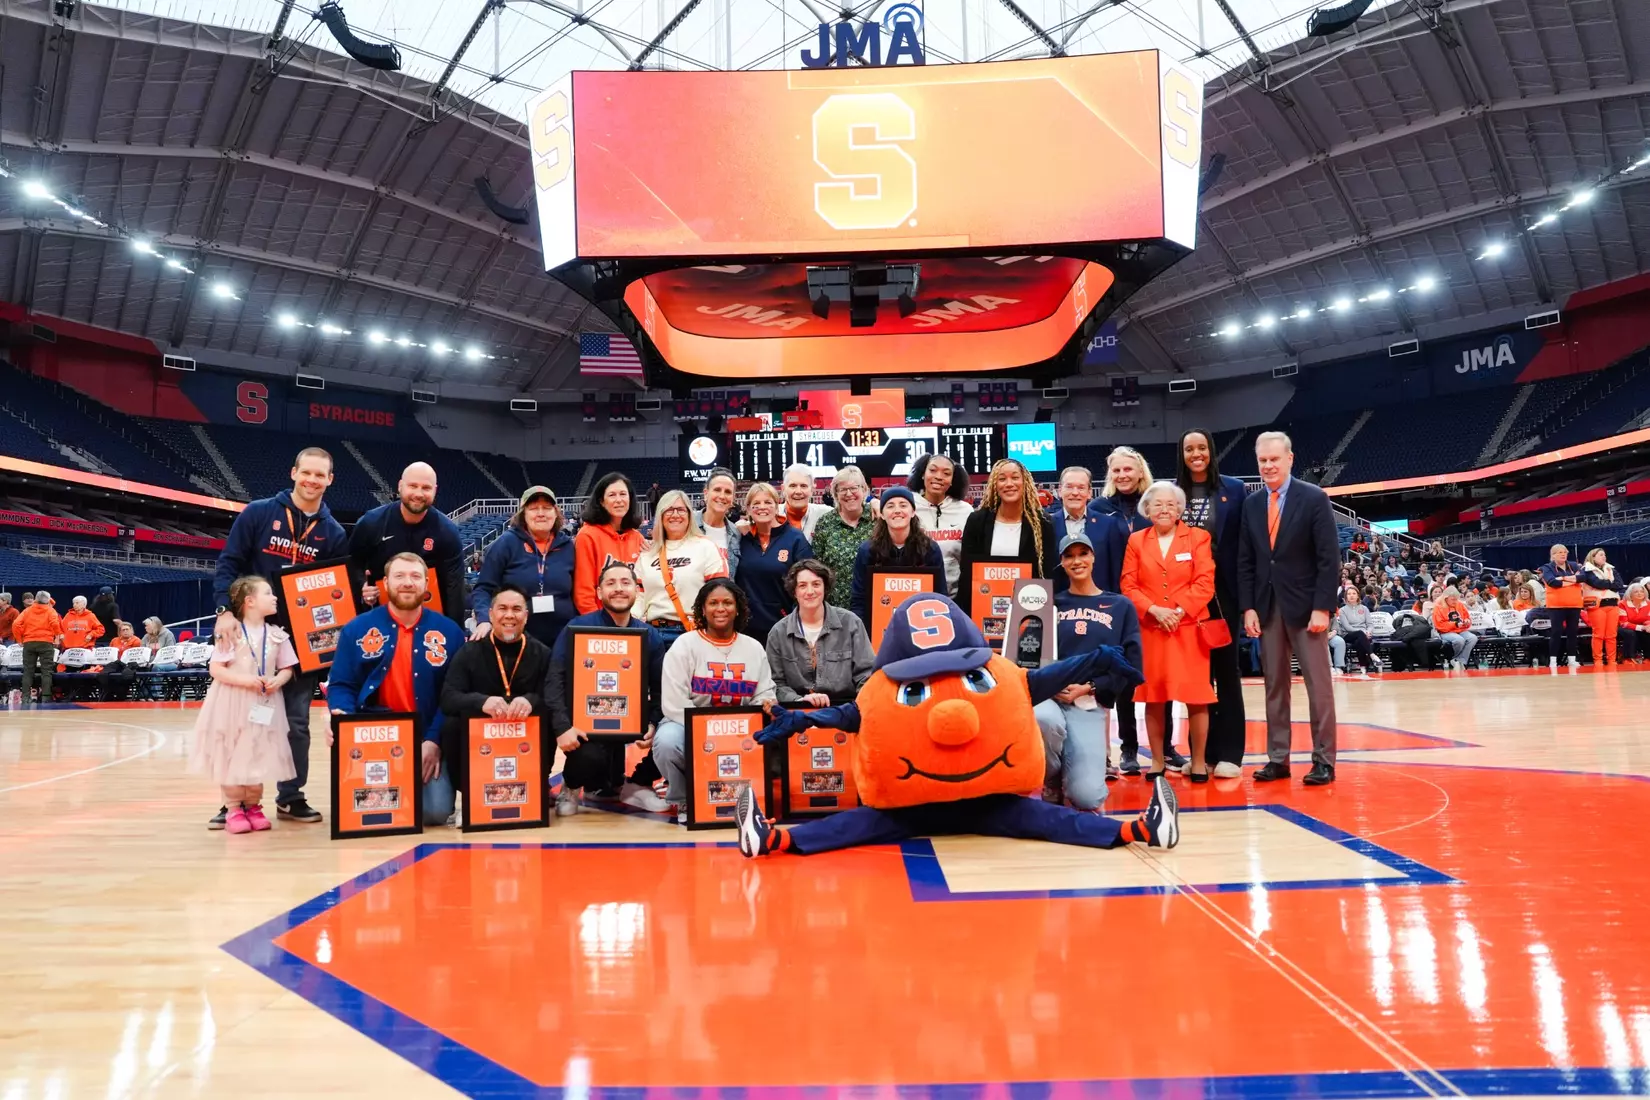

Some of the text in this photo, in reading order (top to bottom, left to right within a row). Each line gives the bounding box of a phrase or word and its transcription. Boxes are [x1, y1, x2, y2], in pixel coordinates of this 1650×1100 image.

[801, 20, 926, 68] JMA
[1163, 67, 1199, 169] S
[532, 90, 573, 191] S
[695, 303, 810, 331] JMA
[909, 294, 1023, 327] JMA
[1454, 342, 1516, 374] JMA
[236, 380, 268, 424] S
[309, 402, 395, 427] SYRACUSE
[842, 404, 862, 429] S
[798, 431, 835, 441] SYRACUSE
[849, 430, 880, 447] 11:33
[805, 443, 824, 466] 41
[905, 440, 926, 464] 30
[684, 469, 699, 478] F.W.
[49, 519, 65, 528] DICK
[272, 519, 282, 531] S
[268, 535, 319, 561] SYRUSE
[423, 537, 434, 551] S
[778, 549, 789, 562] S
[650, 557, 692, 569] Oange
[906, 599, 956, 650] S
[1074, 620, 1088, 635] S
[423, 629, 448, 667] S
